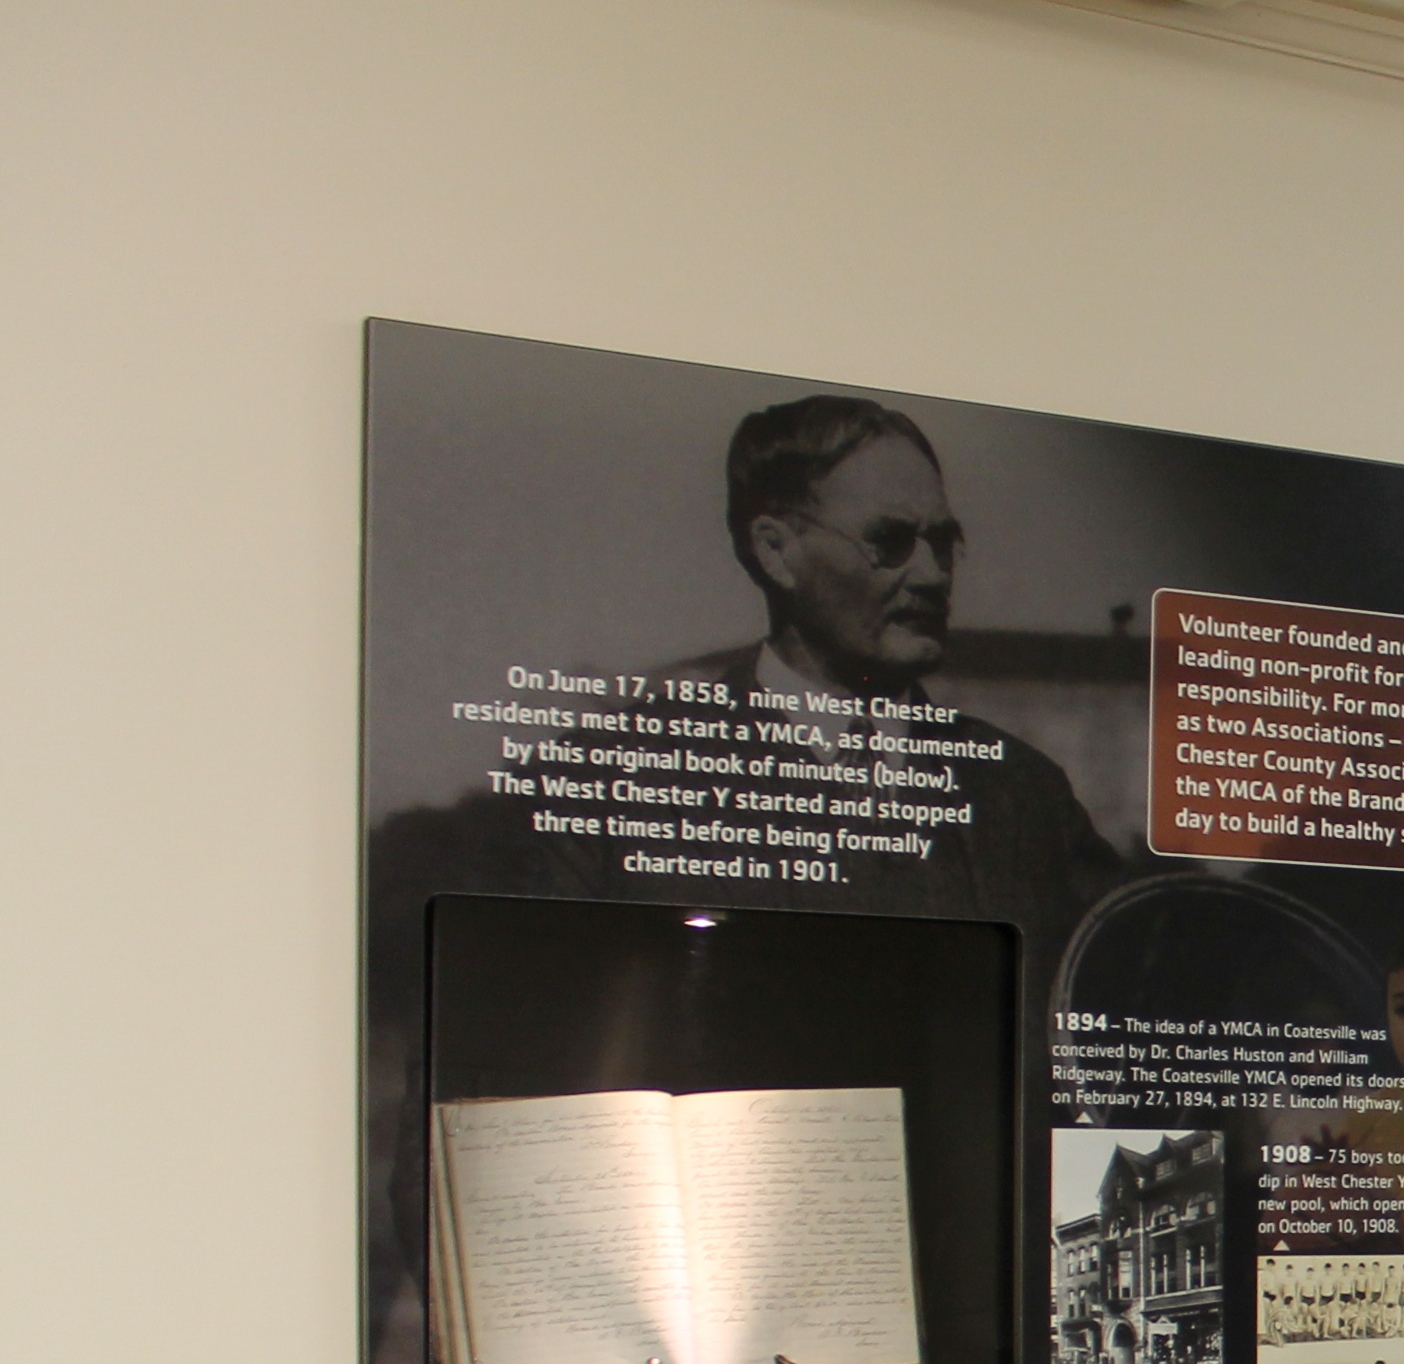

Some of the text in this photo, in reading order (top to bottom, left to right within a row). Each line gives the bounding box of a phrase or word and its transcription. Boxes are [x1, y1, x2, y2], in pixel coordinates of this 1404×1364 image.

[1178, 612, 1284, 643] Volunteer
[1287, 624, 1373, 653] founded
[507, 665, 959, 724] On June 17, 1858, nine West Chester
[1051, 1087, 1403, 1114] on February 27, 1894, at 132 E. Lincoln Highway.
[1257, 1217, 1400, 1235] on October 10, 1908.
